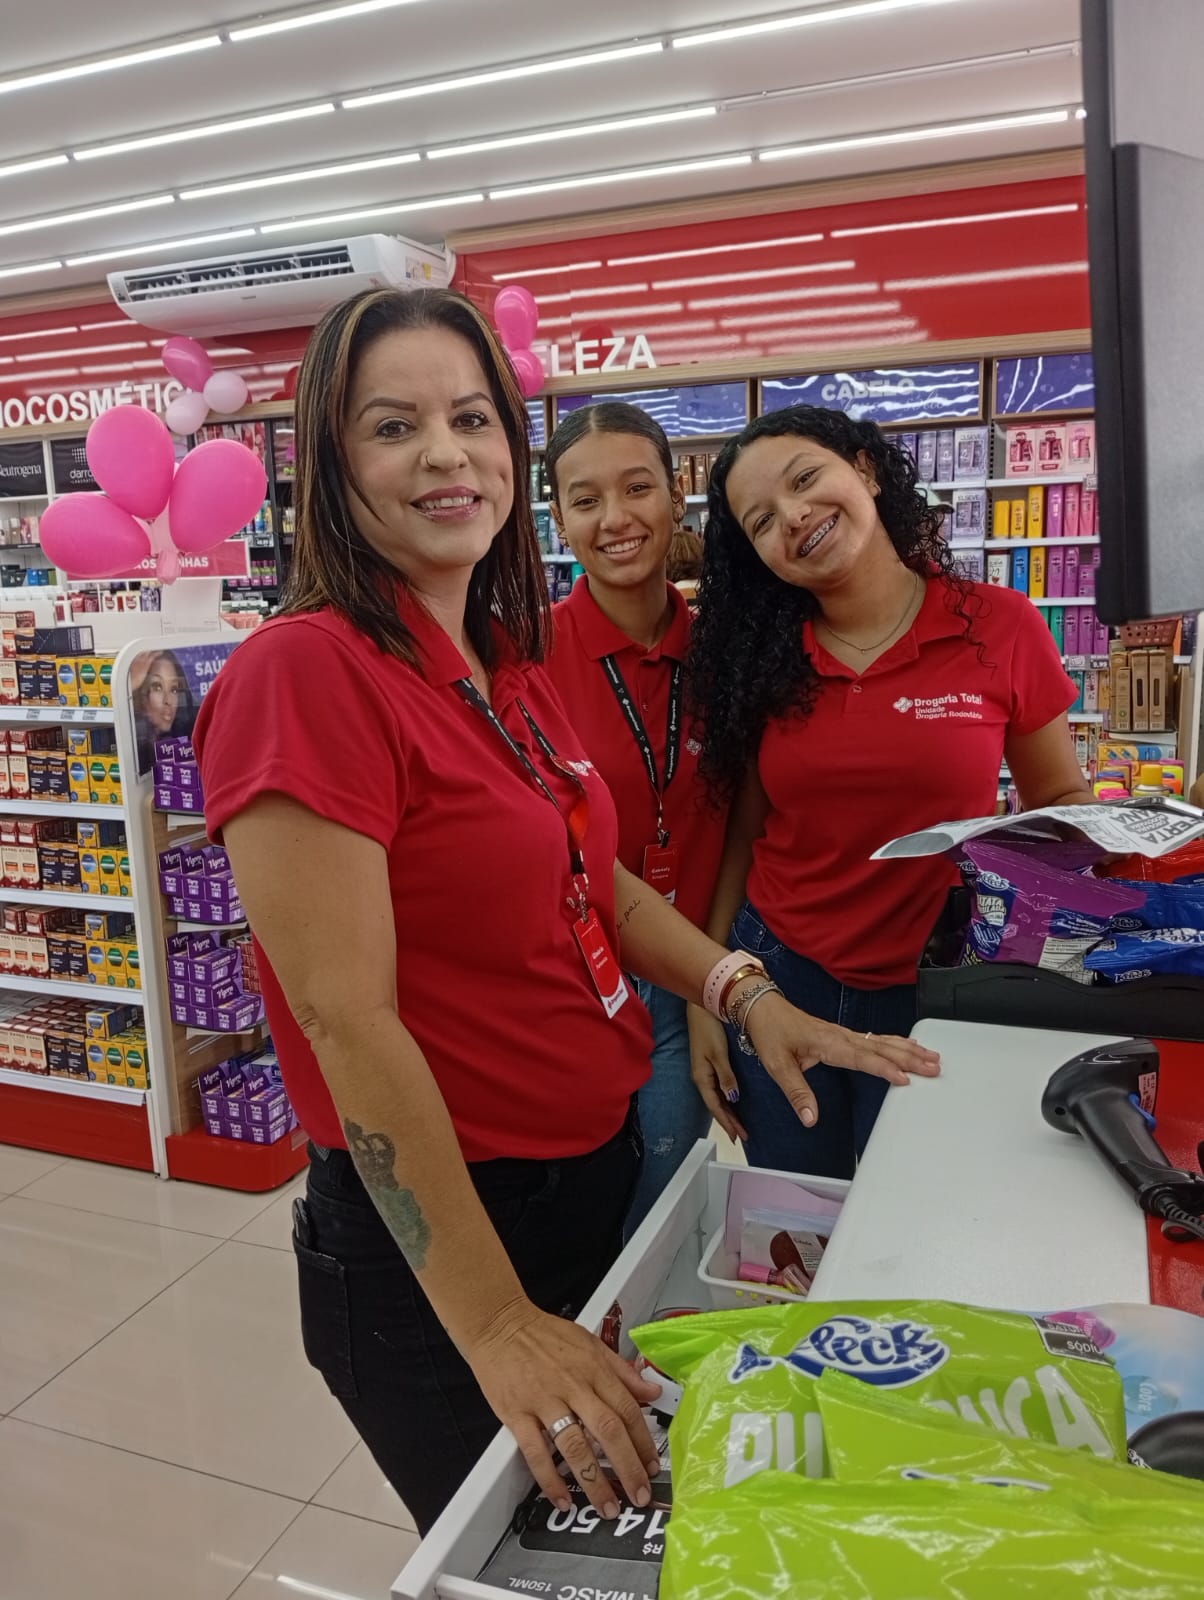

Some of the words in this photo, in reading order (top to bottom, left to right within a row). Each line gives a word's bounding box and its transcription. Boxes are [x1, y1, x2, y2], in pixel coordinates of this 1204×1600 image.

[0, 381, 190, 428] OCOSMÉTIC
[69, 468, 94, 479] darro
[914, 693, 959, 707] Drogaria
[959, 692, 983, 705] Total
[915, 706, 946, 715] Unidade
[642, 1542, 664, 1555] R$
[508, 1576, 552, 1593] 150ML
